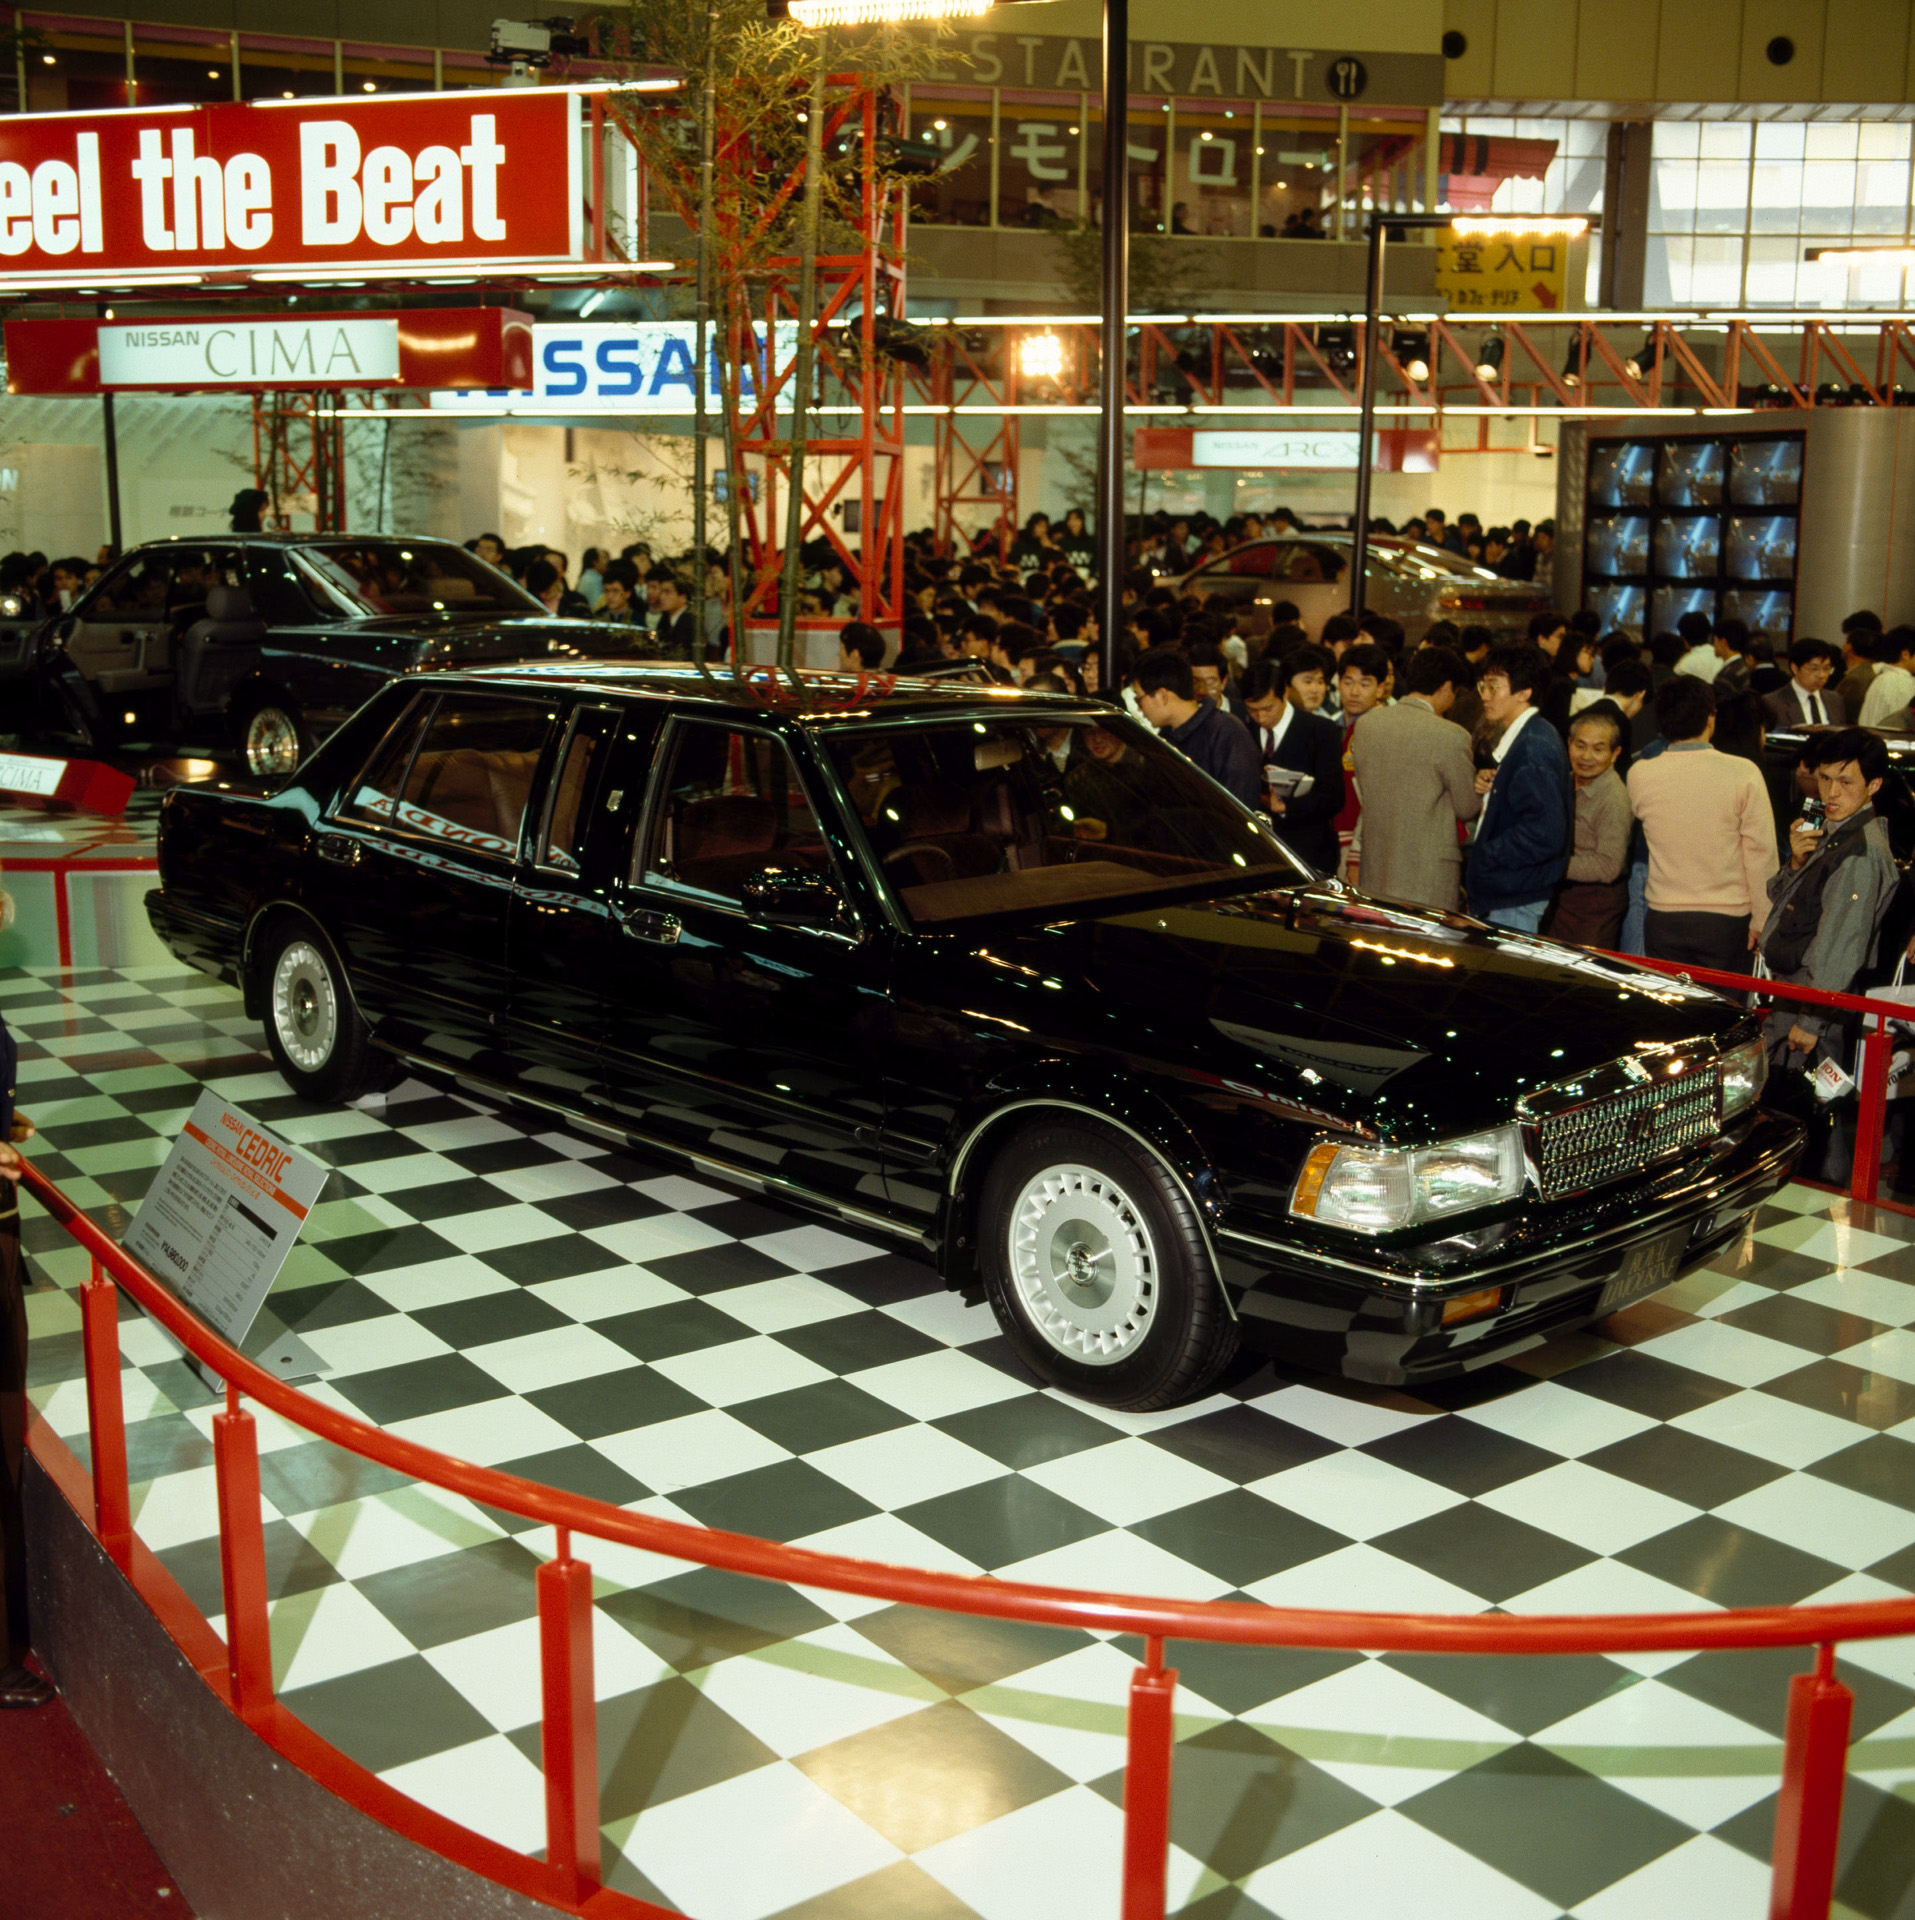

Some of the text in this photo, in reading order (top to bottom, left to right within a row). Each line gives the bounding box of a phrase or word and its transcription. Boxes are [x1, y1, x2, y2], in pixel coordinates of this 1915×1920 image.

[132, 128, 273, 252] the
[299, 114, 506, 246] Beat
[1437, 242, 1556, 273] 堂入口
[125, 327, 362, 377] NISSAN CIMA
[220, 1112, 246, 1136] NISSAN
[235, 1129, 293, 1184] CEDRIC
